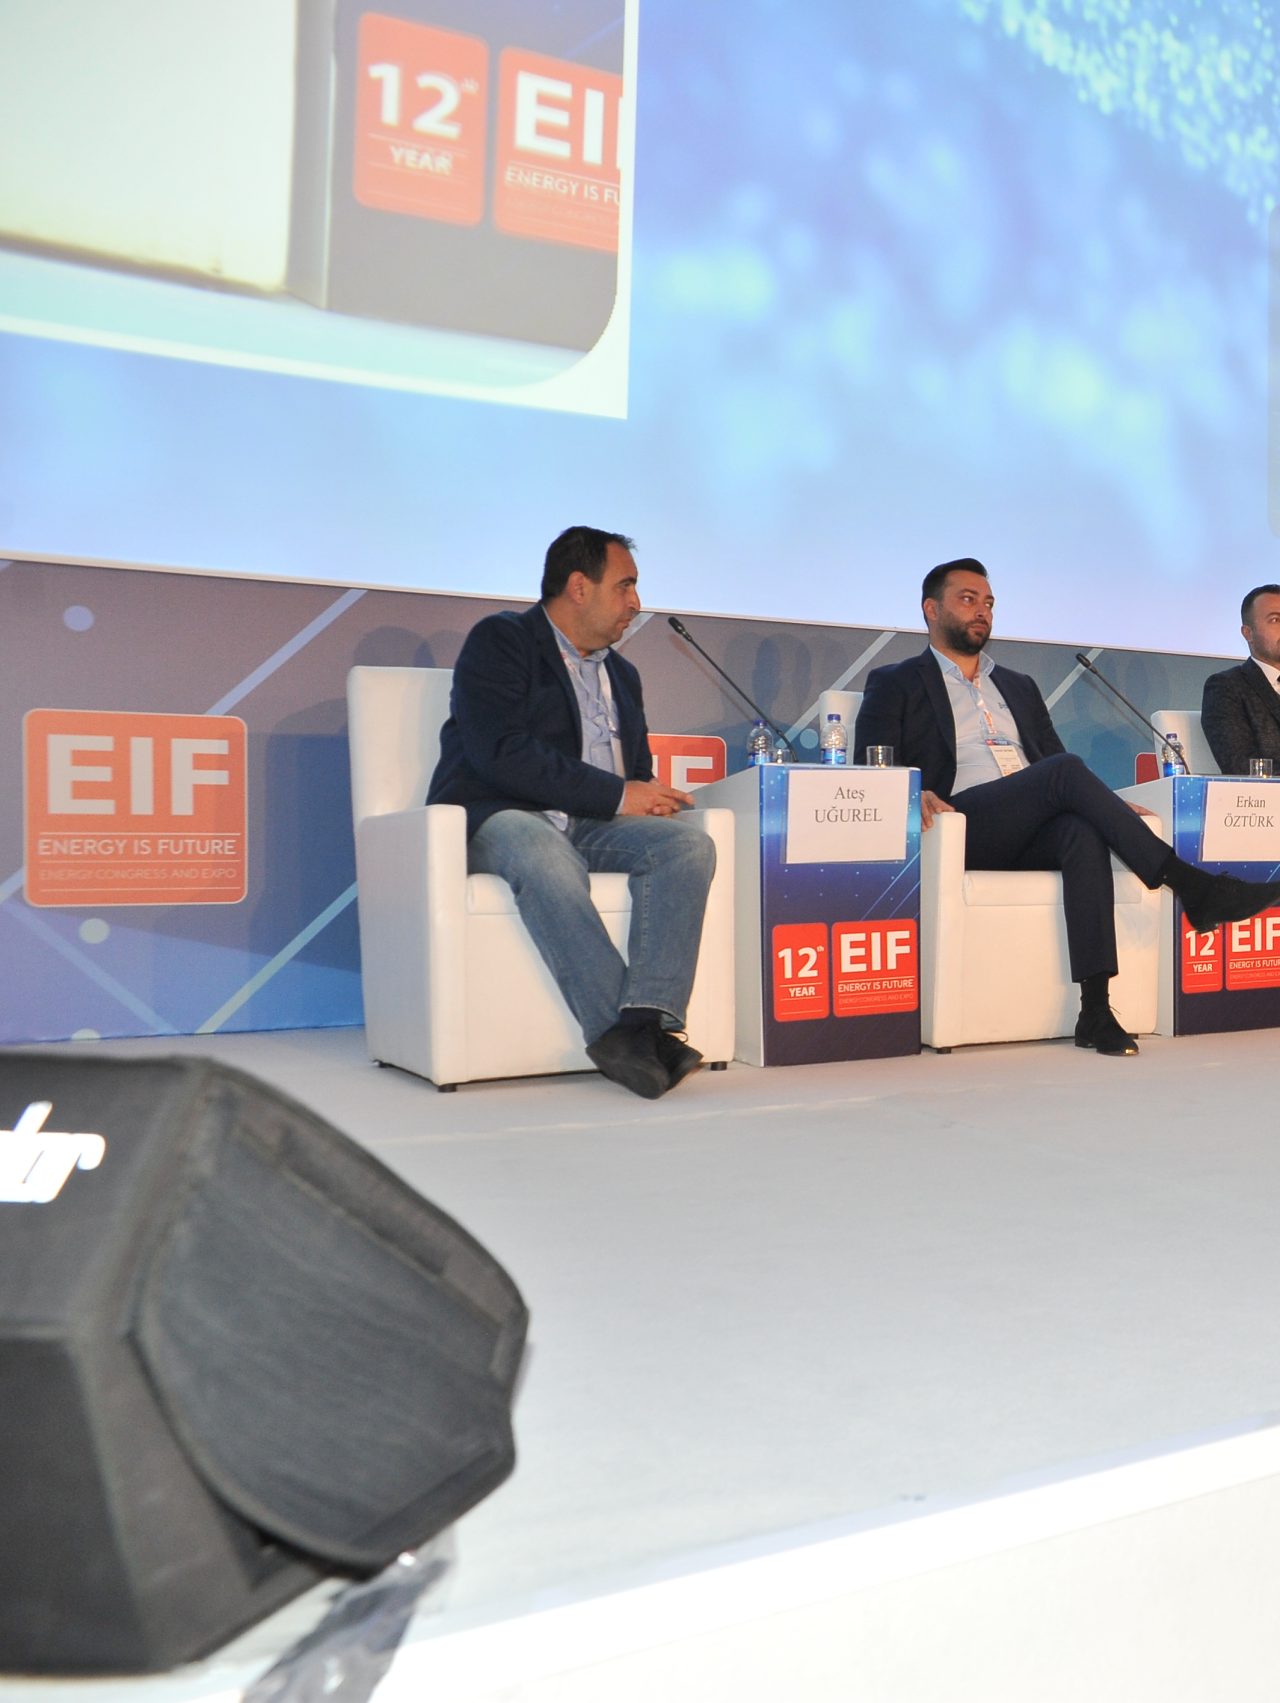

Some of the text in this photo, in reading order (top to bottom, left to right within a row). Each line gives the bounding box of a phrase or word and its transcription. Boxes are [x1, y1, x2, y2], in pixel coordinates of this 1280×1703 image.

[515, 70, 622, 168] EI
[389, 146, 453, 175] YEAR
[505, 166, 580, 196] ENERGY
[583, 182, 599, 200] IS
[47, 734, 230, 816] EIF
[834, 786, 866, 803] Ateş
[1236, 795, 1266, 809] Erkan
[814, 805, 883, 824] UĞUREL
[1224, 813, 1275, 828] ÖZTÜRK
[38, 839, 237, 856] ENERGY IS FUTURE
[172, 868, 199, 880] AND
[201, 867, 237, 879] EXPO
[840, 930, 911, 973] EIF
[778, 945, 825, 979] 12th
[1192, 963, 1213, 973] YEAR
[1229, 960, 1254, 970] ENERGY
[1255, 960, 1261, 968] IS
[789, 986, 816, 997] YEAR
[838, 979, 914, 993] ENERGY IS FUTURE
